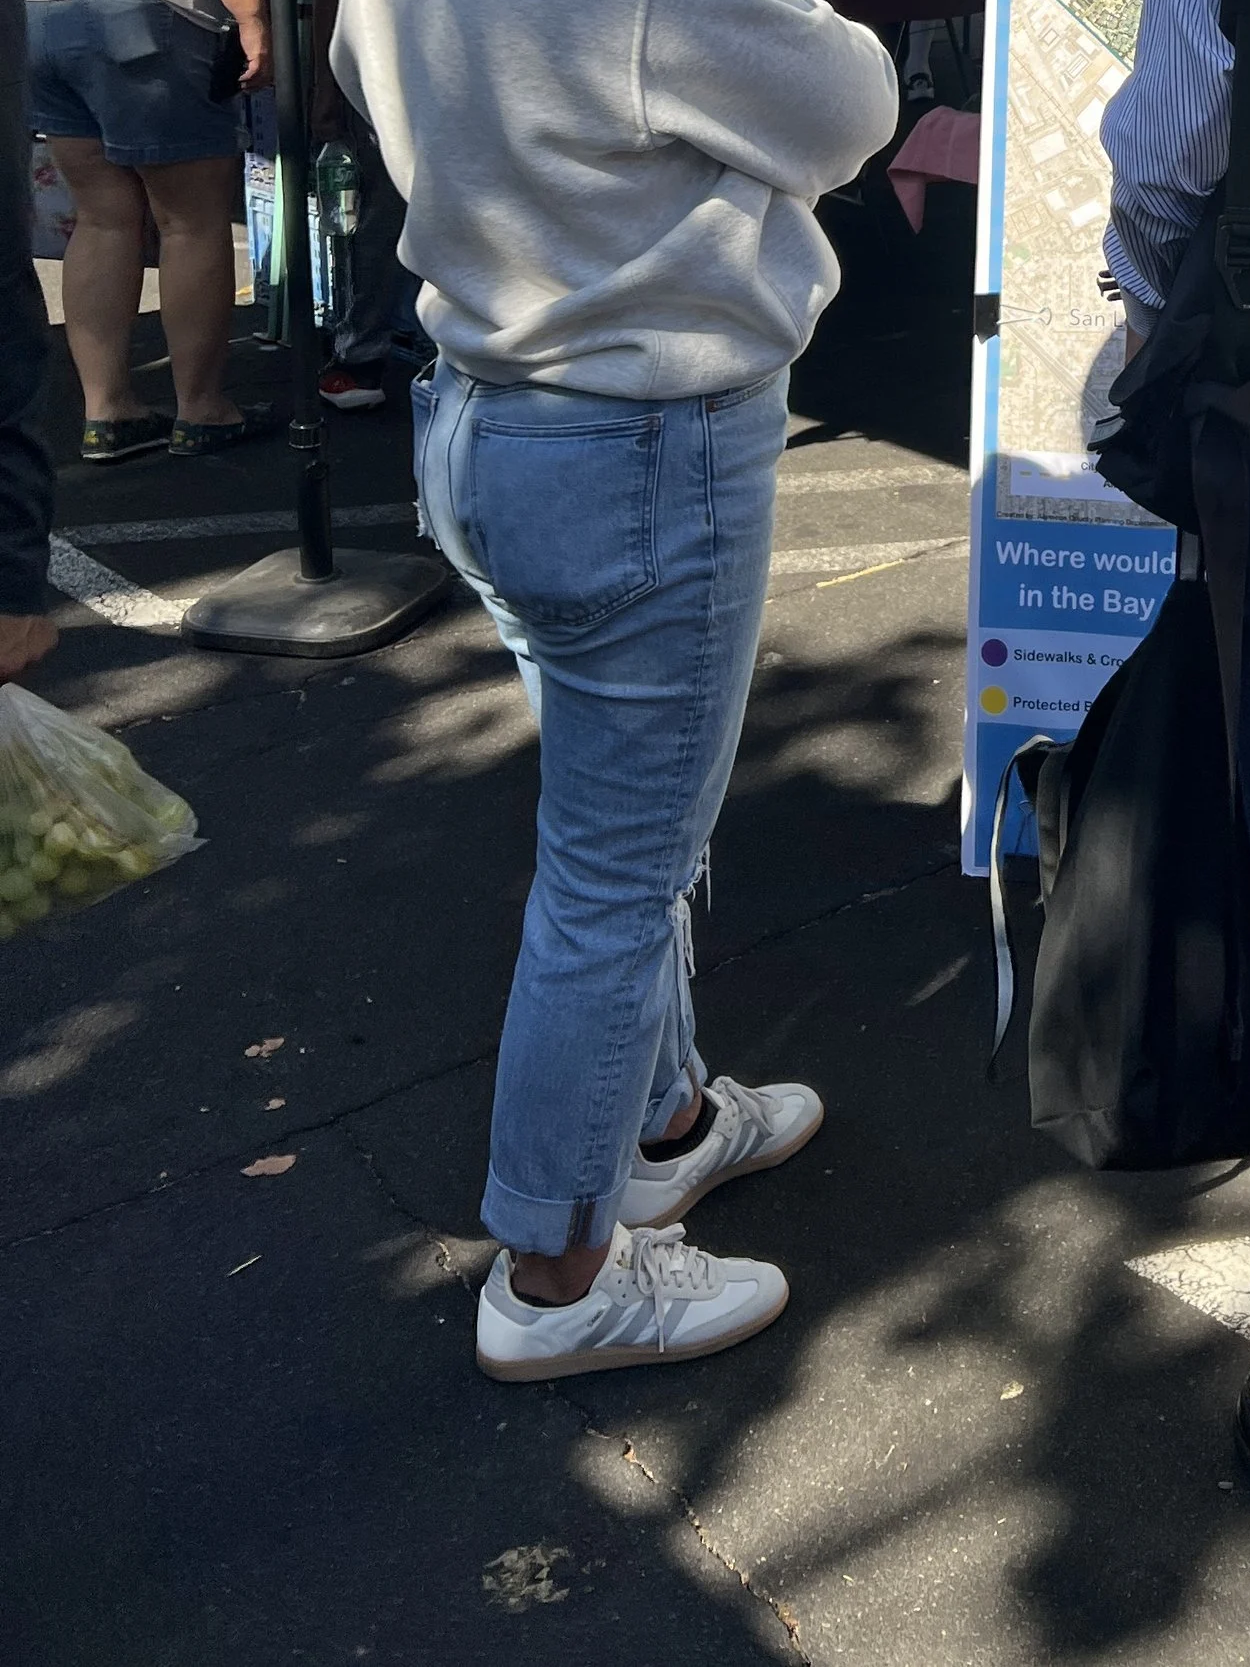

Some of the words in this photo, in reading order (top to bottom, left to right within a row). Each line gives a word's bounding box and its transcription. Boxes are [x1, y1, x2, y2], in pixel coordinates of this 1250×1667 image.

[1070, 308, 1105, 326] San
[996, 541, 1085, 569] Where
[1093, 550, 1177, 575] would
[1019, 583, 1043, 608] in
[1051, 585, 1095, 611] the
[1103, 588, 1155, 622] Bay
[1013, 648, 1082, 665] Sidewalks
[1086, 652, 1097, 665] &
[1013, 696, 1080, 712] Protected
